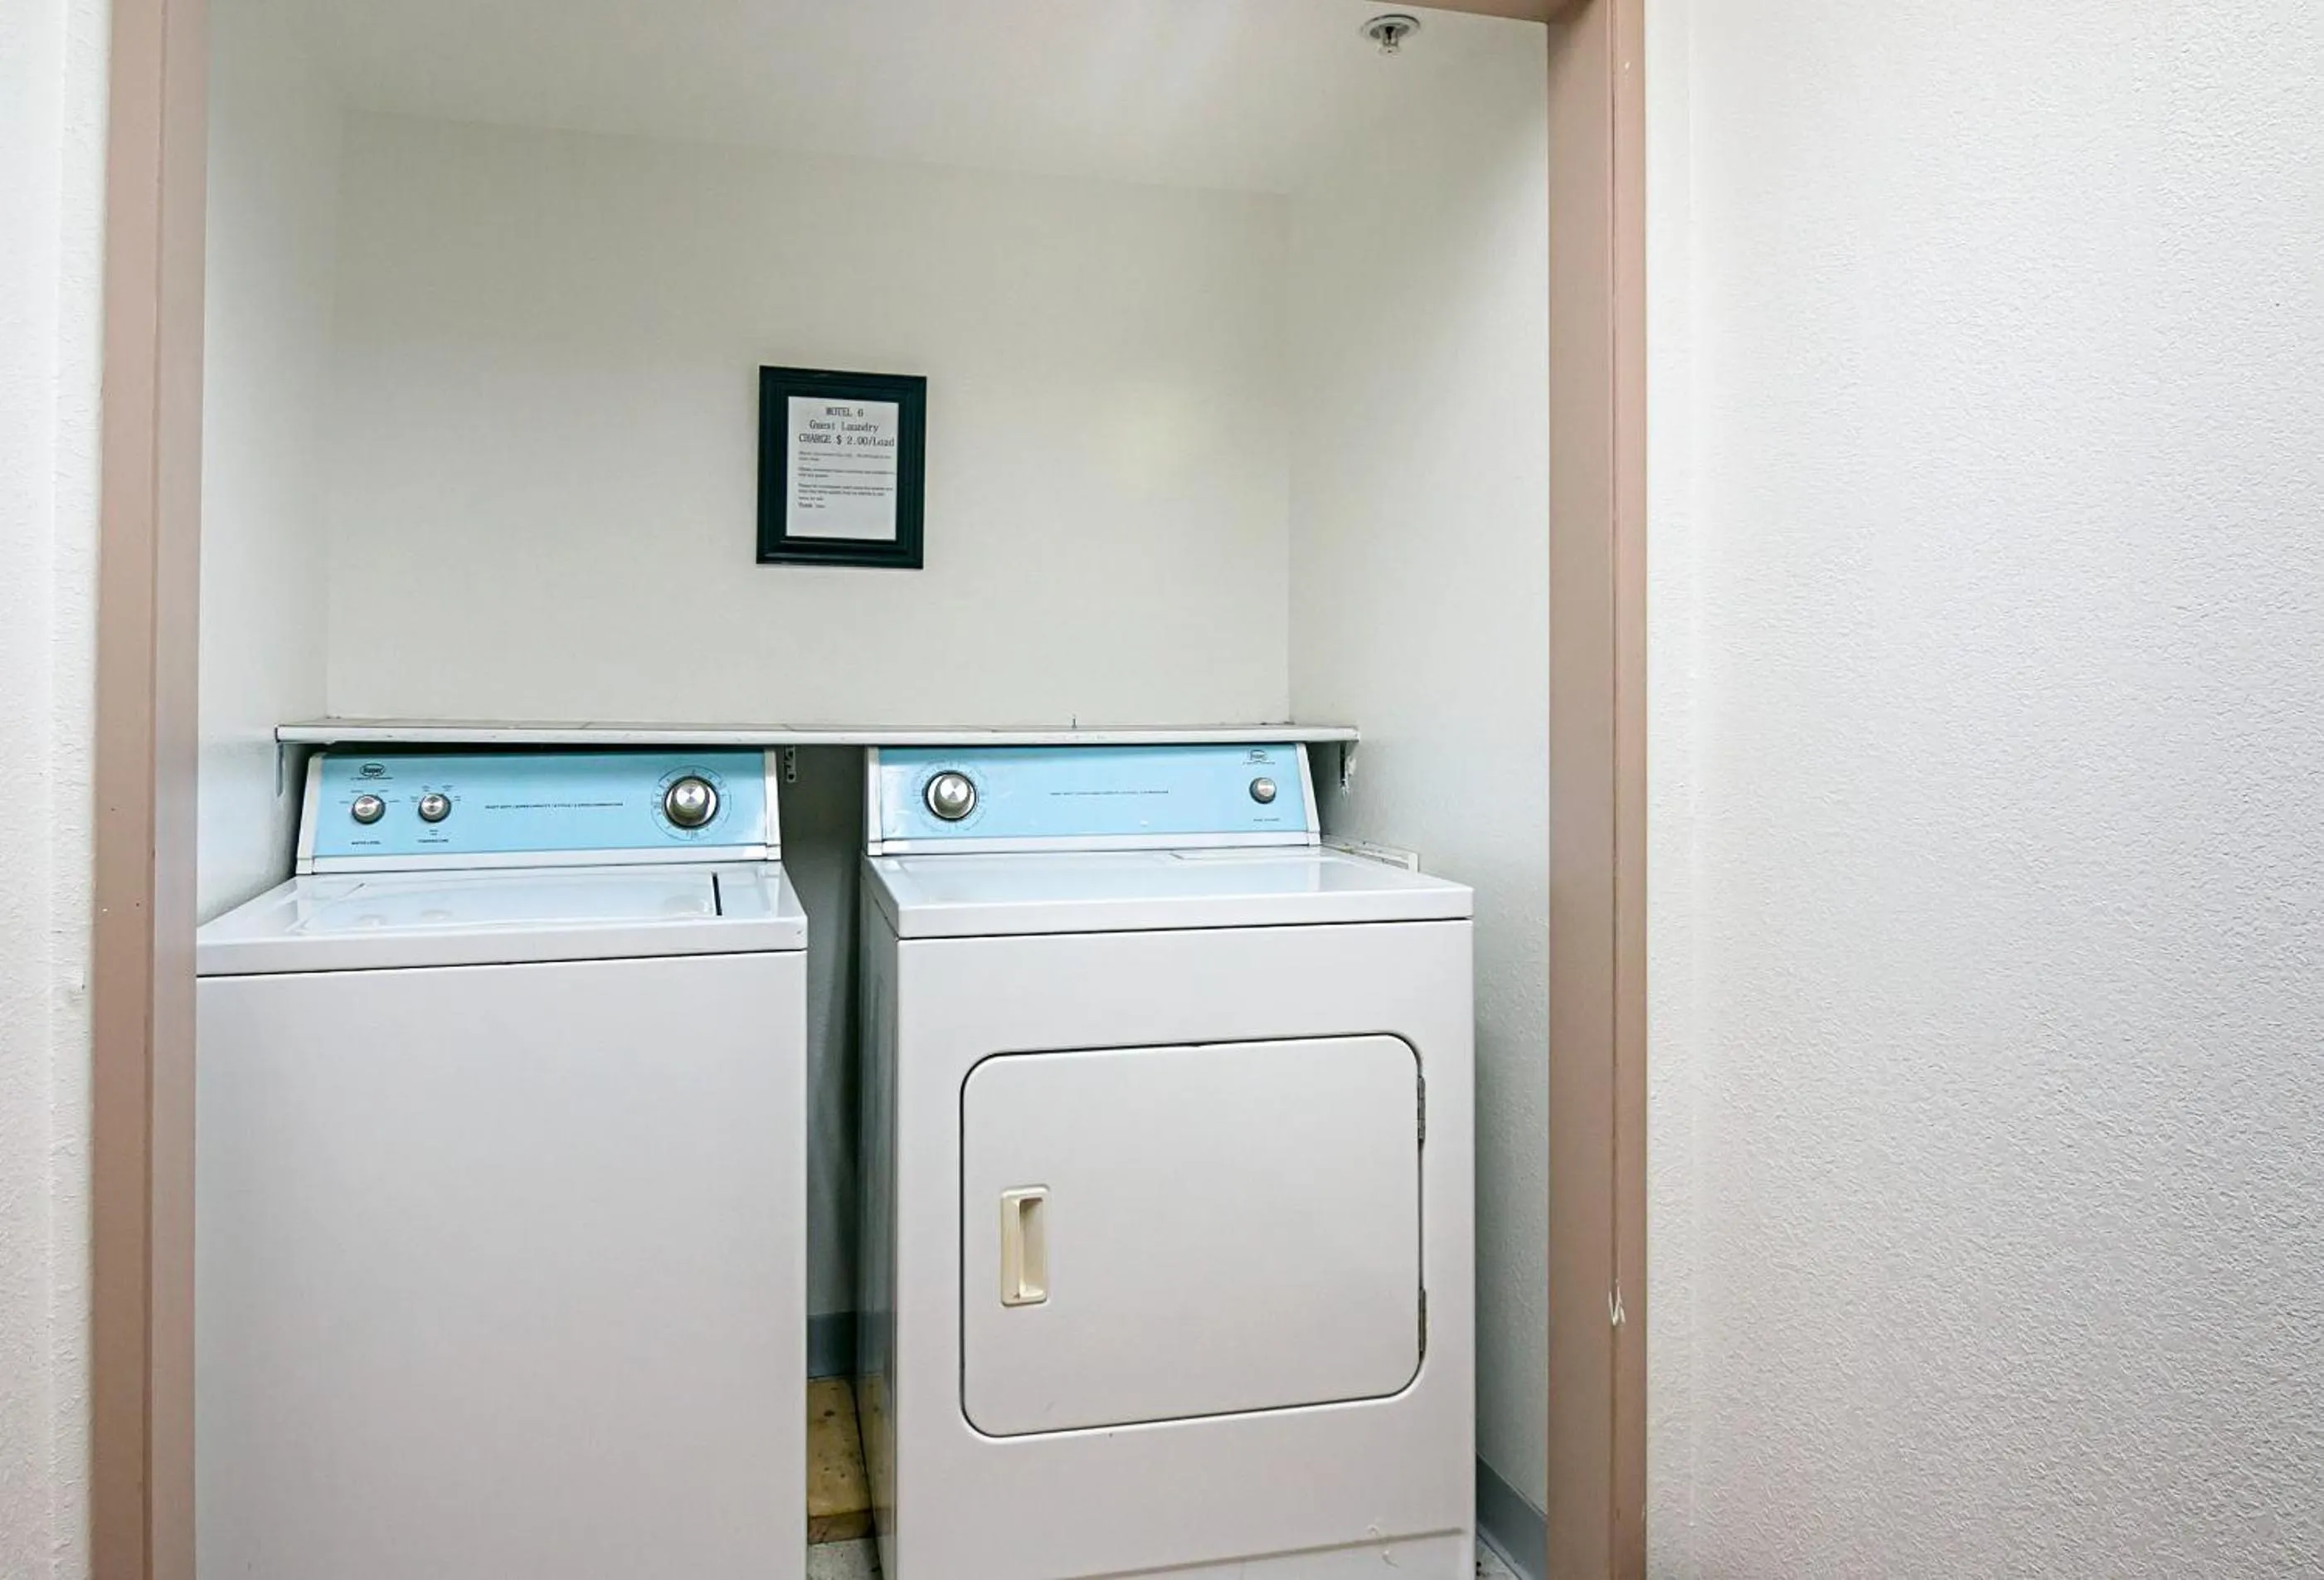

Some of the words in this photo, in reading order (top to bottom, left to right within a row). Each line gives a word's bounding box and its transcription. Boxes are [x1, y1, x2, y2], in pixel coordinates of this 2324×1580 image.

[825, 406, 852, 416] MOTEL
[858, 408, 864, 417] 6
[810, 419, 835, 430] Guest
[841, 421, 879, 433] Laundry
